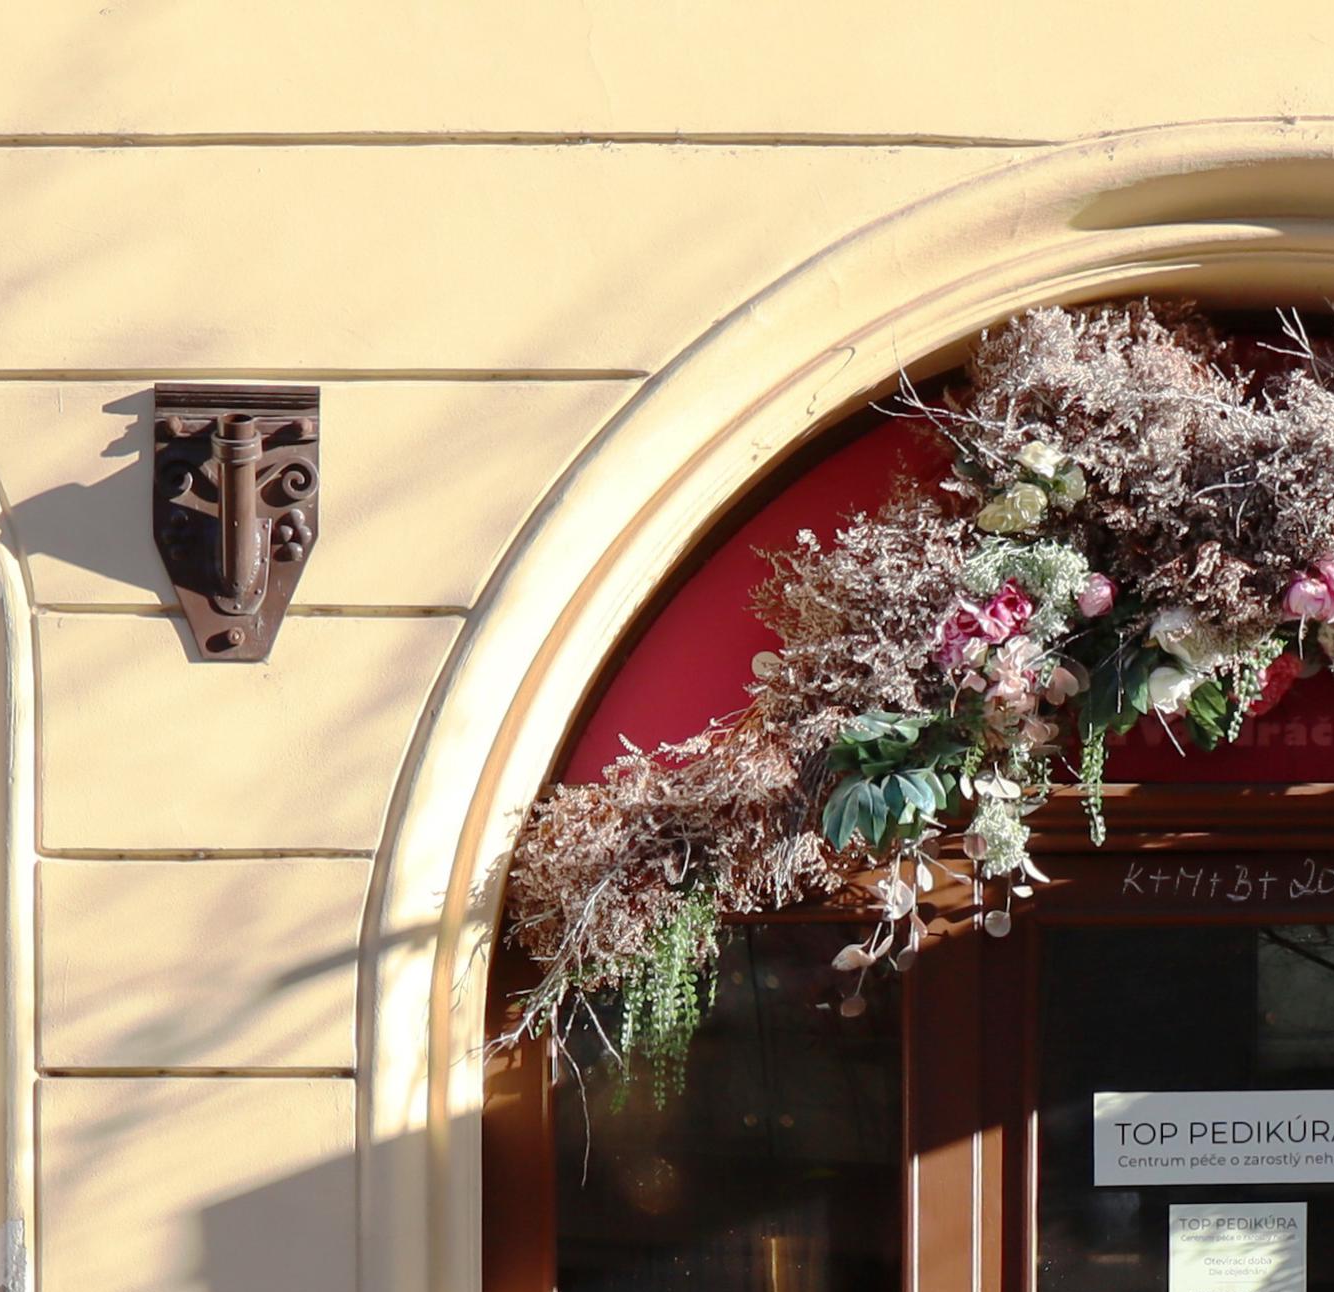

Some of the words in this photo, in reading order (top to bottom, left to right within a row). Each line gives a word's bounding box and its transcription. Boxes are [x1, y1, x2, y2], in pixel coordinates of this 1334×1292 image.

[1115, 1122, 1178, 1146] TOP
[1118, 1155, 1185, 1168] Centrum
[1191, 1153, 1226, 1169] péče
[1230, 1156, 1240, 1166] o
[1243, 1152, 1301, 1168] zarostlý
[1179, 1217, 1212, 1231] TOP
[1216, 1213, 1298, 1231] PEDIKÚRA
